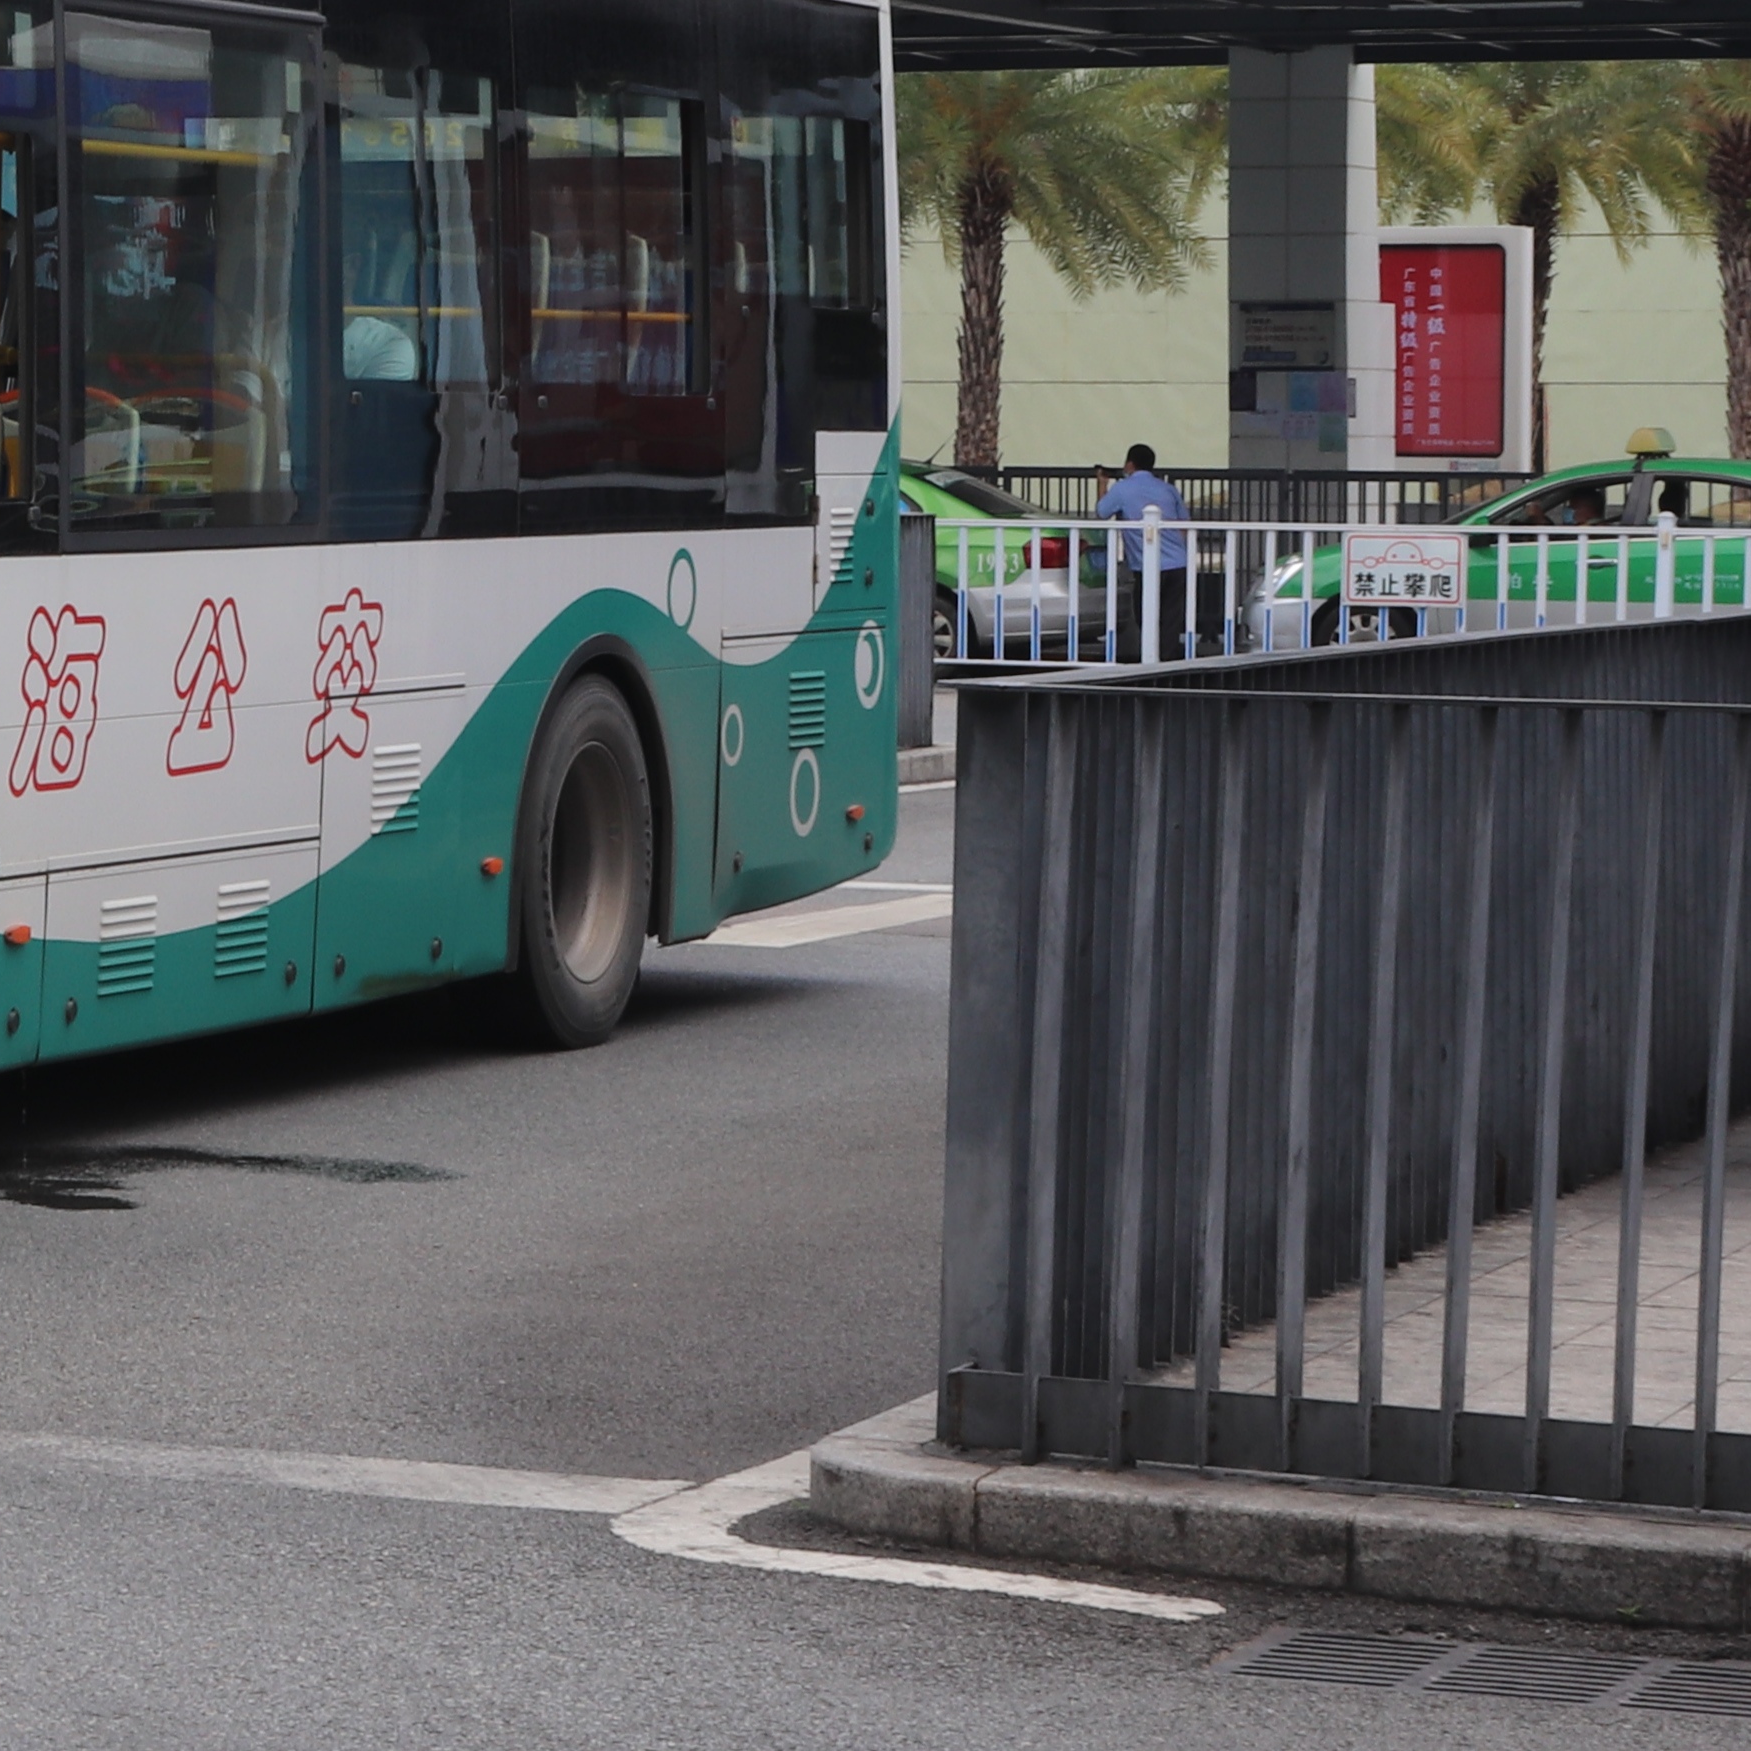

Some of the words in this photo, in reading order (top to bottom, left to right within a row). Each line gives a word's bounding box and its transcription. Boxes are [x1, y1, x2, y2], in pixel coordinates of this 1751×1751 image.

[977, 552, 1018, 574] 193
[1354, 572, 1451, 598] 禁止攀爬
